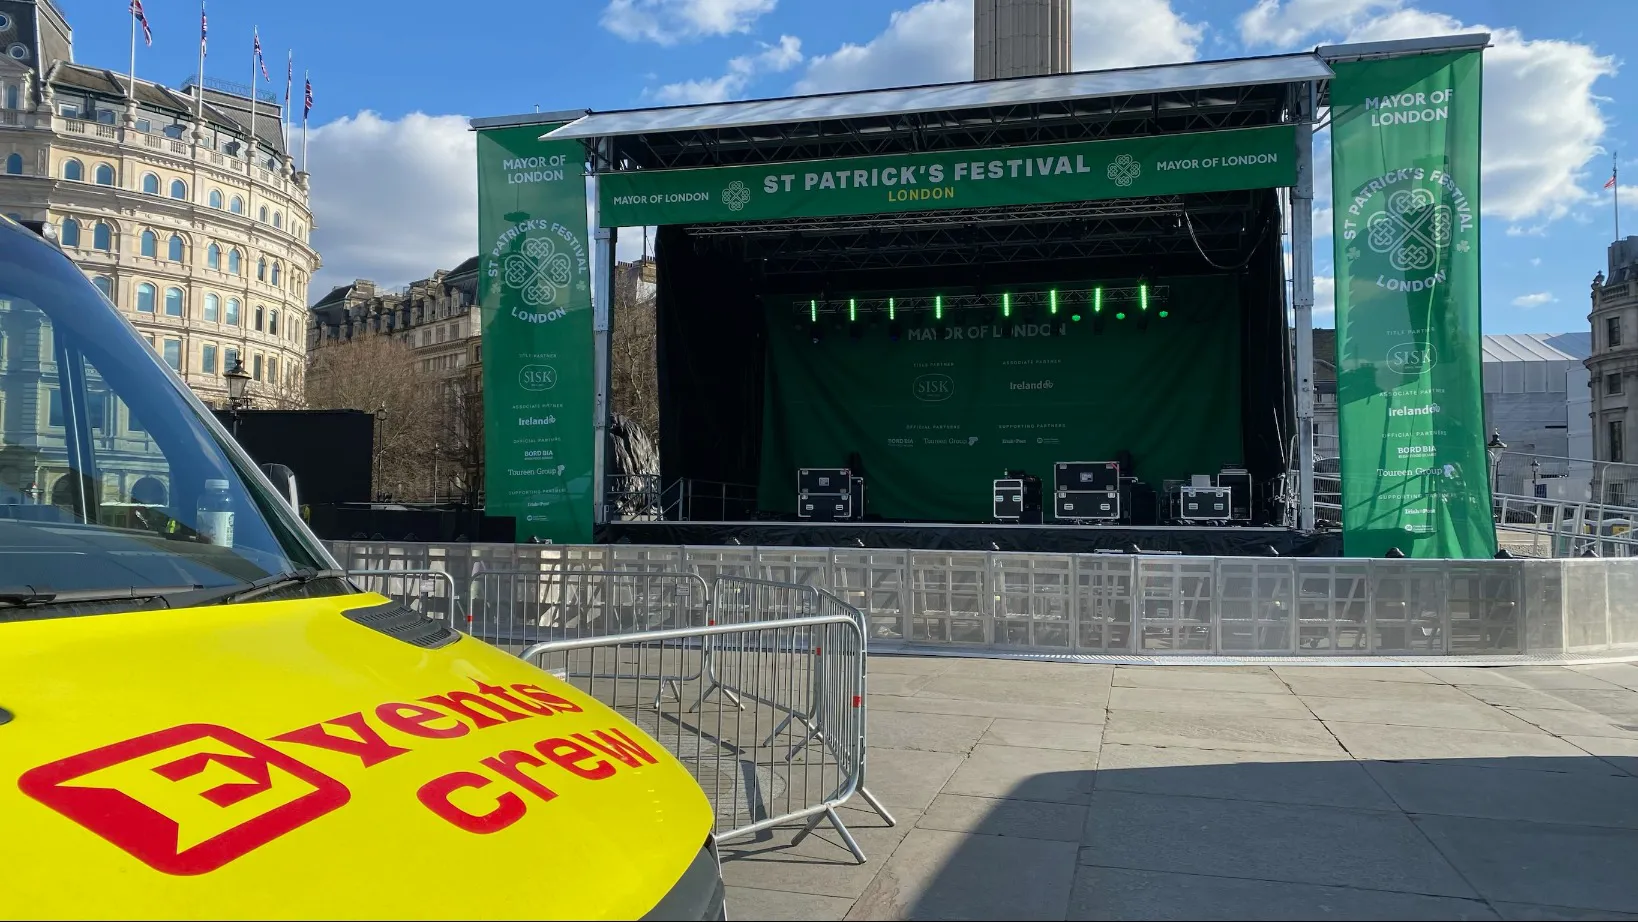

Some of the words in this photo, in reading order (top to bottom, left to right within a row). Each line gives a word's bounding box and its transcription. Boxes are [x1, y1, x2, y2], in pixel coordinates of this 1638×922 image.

[1365, 92, 1425, 110] MAYOR
[1430, 88, 1453, 105] OF
[1371, 106, 1449, 127] LONDON
[503, 156, 547, 170] MAYOR
[549, 155, 566, 166] OF
[1156, 157, 1199, 171] MAYOR
[1202, 156, 1219, 168] OF
[1222, 153, 1277, 167] LONDON
[507, 169, 564, 184] LONDON
[763, 174, 795, 194] ST
[804, 164, 944, 191] PATRICK'S
[954, 154, 1091, 181] FESTIVAL
[613, 195, 648, 206] MAYOR
[649, 194, 664, 204] OF
[665, 192, 709, 203] LONDON
[888, 186, 954, 202] LONDON
[1348, 167, 1425, 216] PATRICK'S
[1429, 169, 1473, 233] FESTIVAL
[492, 219, 547, 257] PATRICK'S
[1344, 219, 1357, 240] ST
[550, 222, 587, 275] FESTIVAL
[488, 259, 499, 278] ST
[1376, 269, 1447, 292] LONDON
[511, 306, 566, 324] LONDON
[967, 326, 988, 339] OF
[992, 323, 1066, 338] LNDON
[1394, 348, 1432, 366] SISK
[524, 371, 552, 384] SISK
[918, 380, 949, 393] SISK
[1388, 404, 1429, 417] Ireland
[518, 416, 549, 426] Ireland
[1397, 446, 1422, 454] BORD
[1422, 445, 1437, 453] BIA
[507, 468, 535, 476] Toureen
[536, 467, 557, 475] Group
[1376, 468, 1413, 477] Toureen
[1415, 467, 1443, 476] Group
[416, 727, 659, 835] crew
